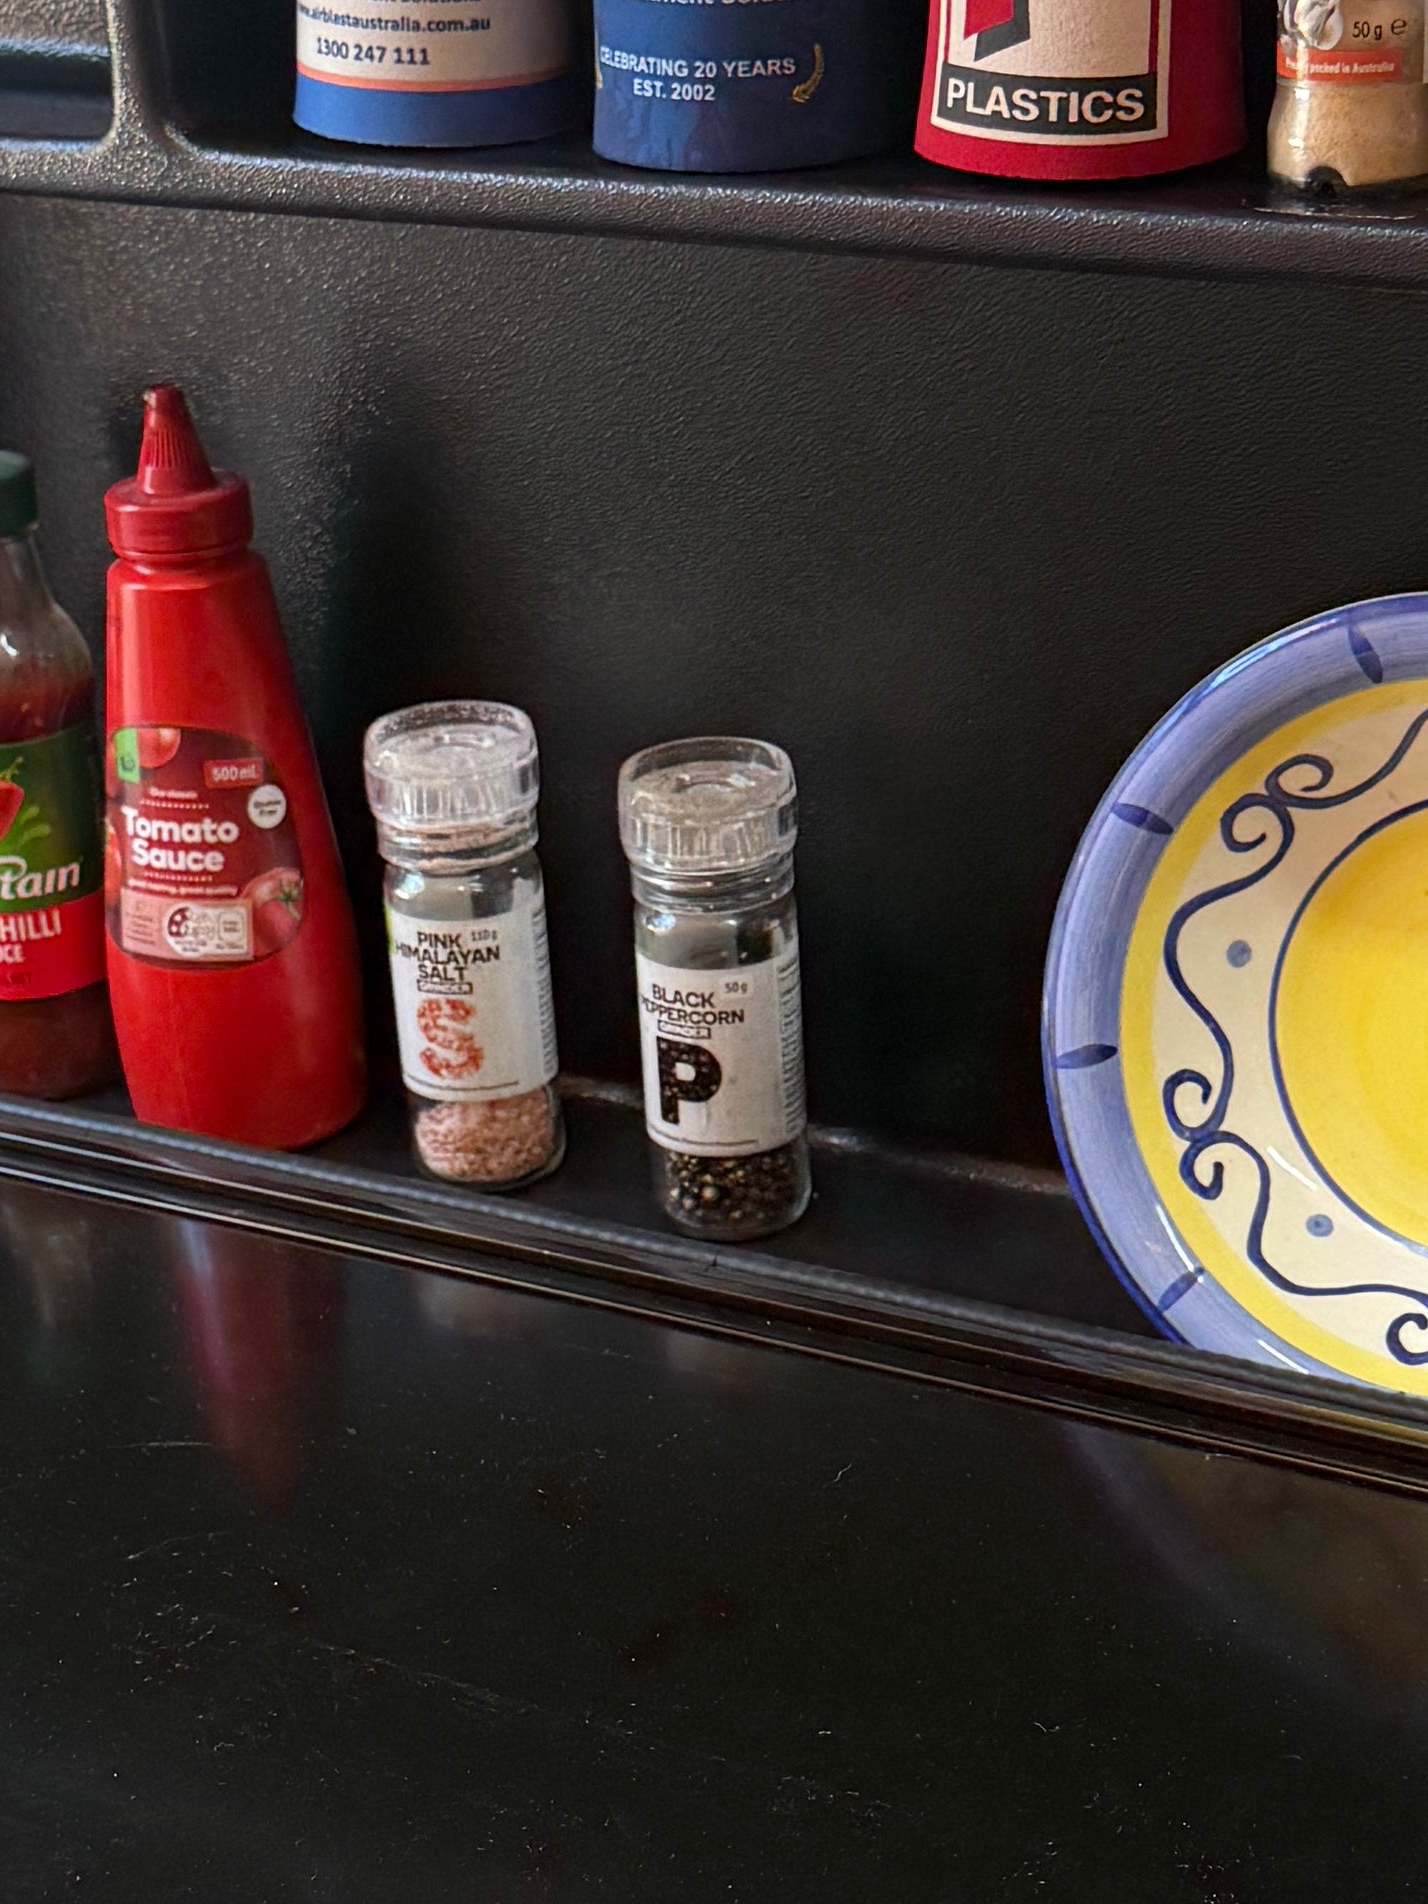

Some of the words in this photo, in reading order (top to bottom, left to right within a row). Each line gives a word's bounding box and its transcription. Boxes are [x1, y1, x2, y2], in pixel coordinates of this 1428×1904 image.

[1352, 21, 1370, 39] 50
[1374, 24, 1383, 41] g
[317, 37, 349, 59] 1300
[354, 44, 386, 63] 247
[394, 48, 431, 65] 111
[600, 46, 688, 77] CELEBRATING
[694, 61, 717, 78] 20
[723, 58, 796, 77] YEARS
[634, 78, 666, 99] EST.
[671, 83, 715, 101] 2002
[946, 77, 1145, 124] PLASTICS
[120, 805, 239, 844] Tomato
[132, 838, 225, 872] Sauce
[396, 941, 501, 965] HIMALAYAN
[417, 931, 462, 948] PINK
[418, 964, 468, 981] SALT
[652, 983, 716, 1009] BLACK
[417, 997, 484, 1079] S
[657, 1036, 722, 1125] P
